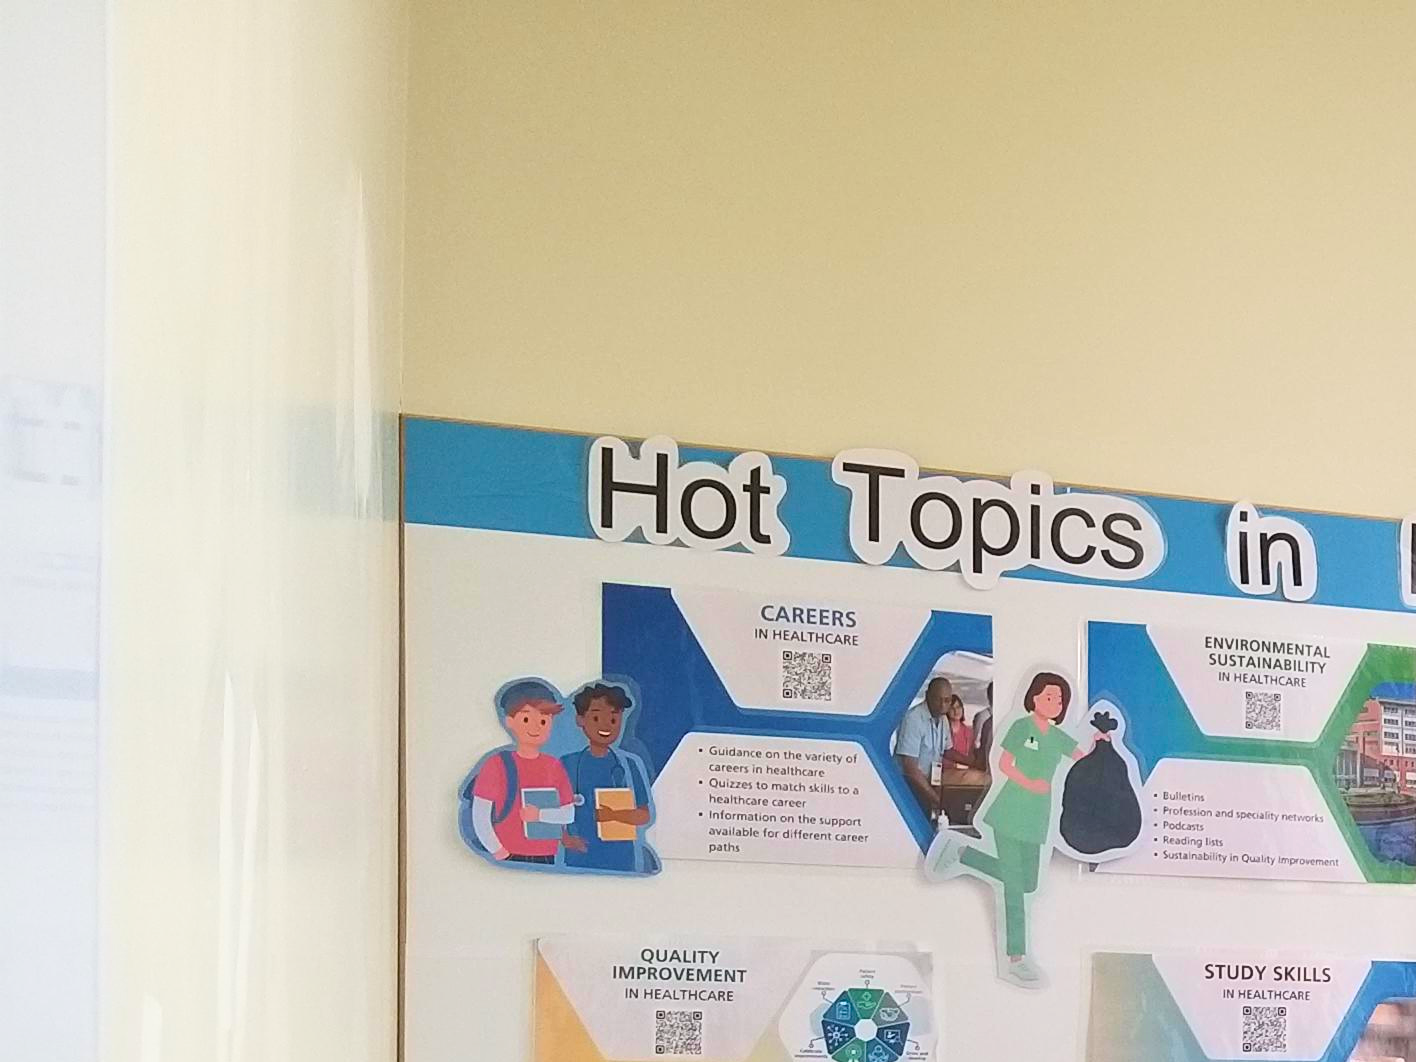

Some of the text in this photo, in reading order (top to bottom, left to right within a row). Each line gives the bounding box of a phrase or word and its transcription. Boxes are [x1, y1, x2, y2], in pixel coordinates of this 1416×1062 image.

[601, 447, 770, 545] Hot
[843, 462, 1143, 574] Topics
[1239, 511, 1302, 587] in
[761, 605, 856, 628] CAREERS
[755, 629, 858, 646] IN HEALTHCARE
[1205, 636, 1330, 658] ENVIRONMENTAL
[1209, 653, 1326, 674] SUSTAINABILITY
[1219, 672, 1306, 687] IN HEALTHCARE
[709, 746, 857, 765] Guidance on the variety of
[709, 764, 825, 777] careers in healthcare
[709, 778, 752, 790] Quizzes
[756, 781, 768, 790] to
[771, 782, 805, 792] match
[809, 783, 834, 794] skills
[838, 786, 850, 795] to
[709, 794, 806, 808] healthcare career
[1163, 792, 1204, 801] Bulletins
[709, 810, 776, 822] Information
[798, 814, 816, 824] the
[819, 817, 861, 828] support
[1163, 806, 1324, 822] Profession and speciality networks
[709, 826, 868, 842] available for different career
[1163, 821, 1204, 831] Podcasts
[709, 842, 740, 853] paths
[1163, 836, 1223, 848] Reading lists
[1163, 850, 1338, 866] Sustainability in Quality Improvement
[641, 949, 719, 964] QUALITY
[613, 966, 747, 982] IMPROVEMENT
[1205, 964, 1331, 982] STUDY SKILLS
[625, 988, 733, 1001] IN HEALTHCARE
[1223, 989, 1310, 1000] IN HEALTHCARE
